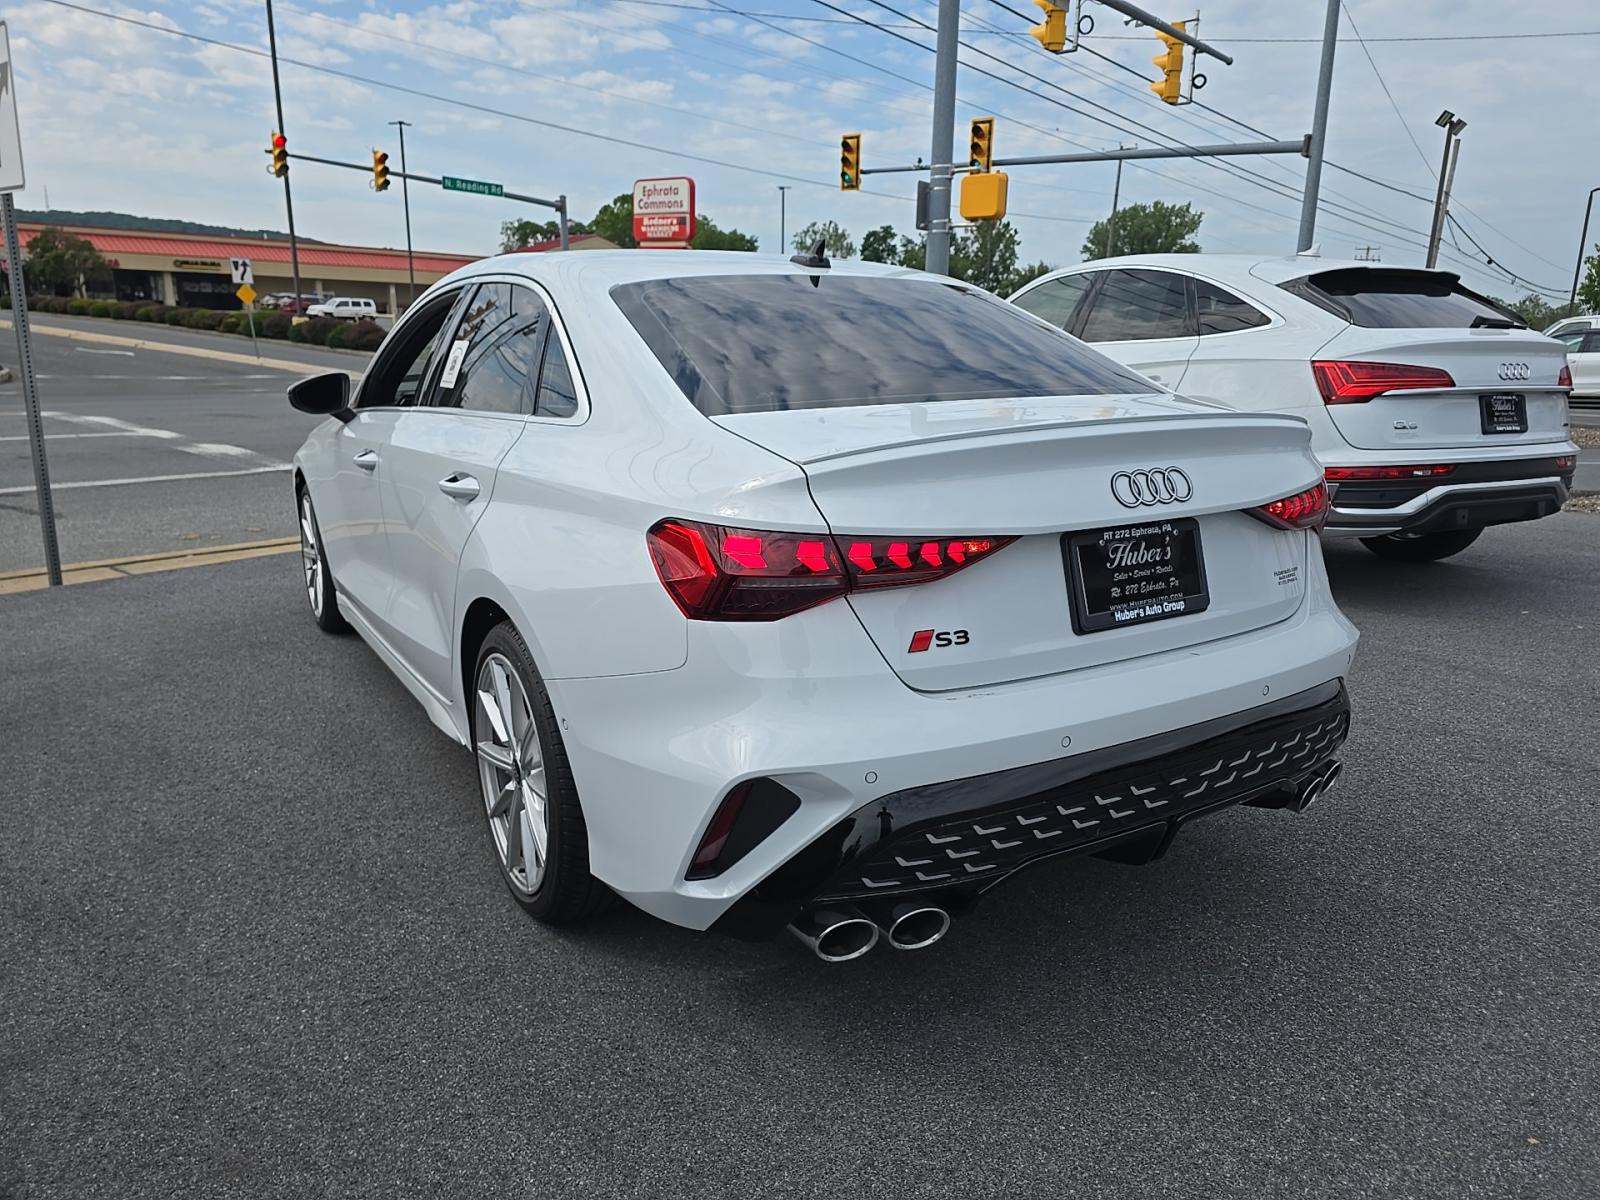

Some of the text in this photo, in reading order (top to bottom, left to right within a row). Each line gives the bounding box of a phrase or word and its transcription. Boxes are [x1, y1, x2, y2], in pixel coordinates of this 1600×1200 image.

[642, 185, 679, 199] Ephrata
[638, 198, 684, 210] Commons
[1103, 531, 1114, 541] RT
[1115, 529, 1130, 539] 272
[1162, 523, 1172, 532] PA
[1106, 536, 1172, 569] Huber's
[1125, 583, 1139, 595] 272
[1114, 600, 1185, 622] Huber's Auto Group
[935, 629, 970, 648] S3
